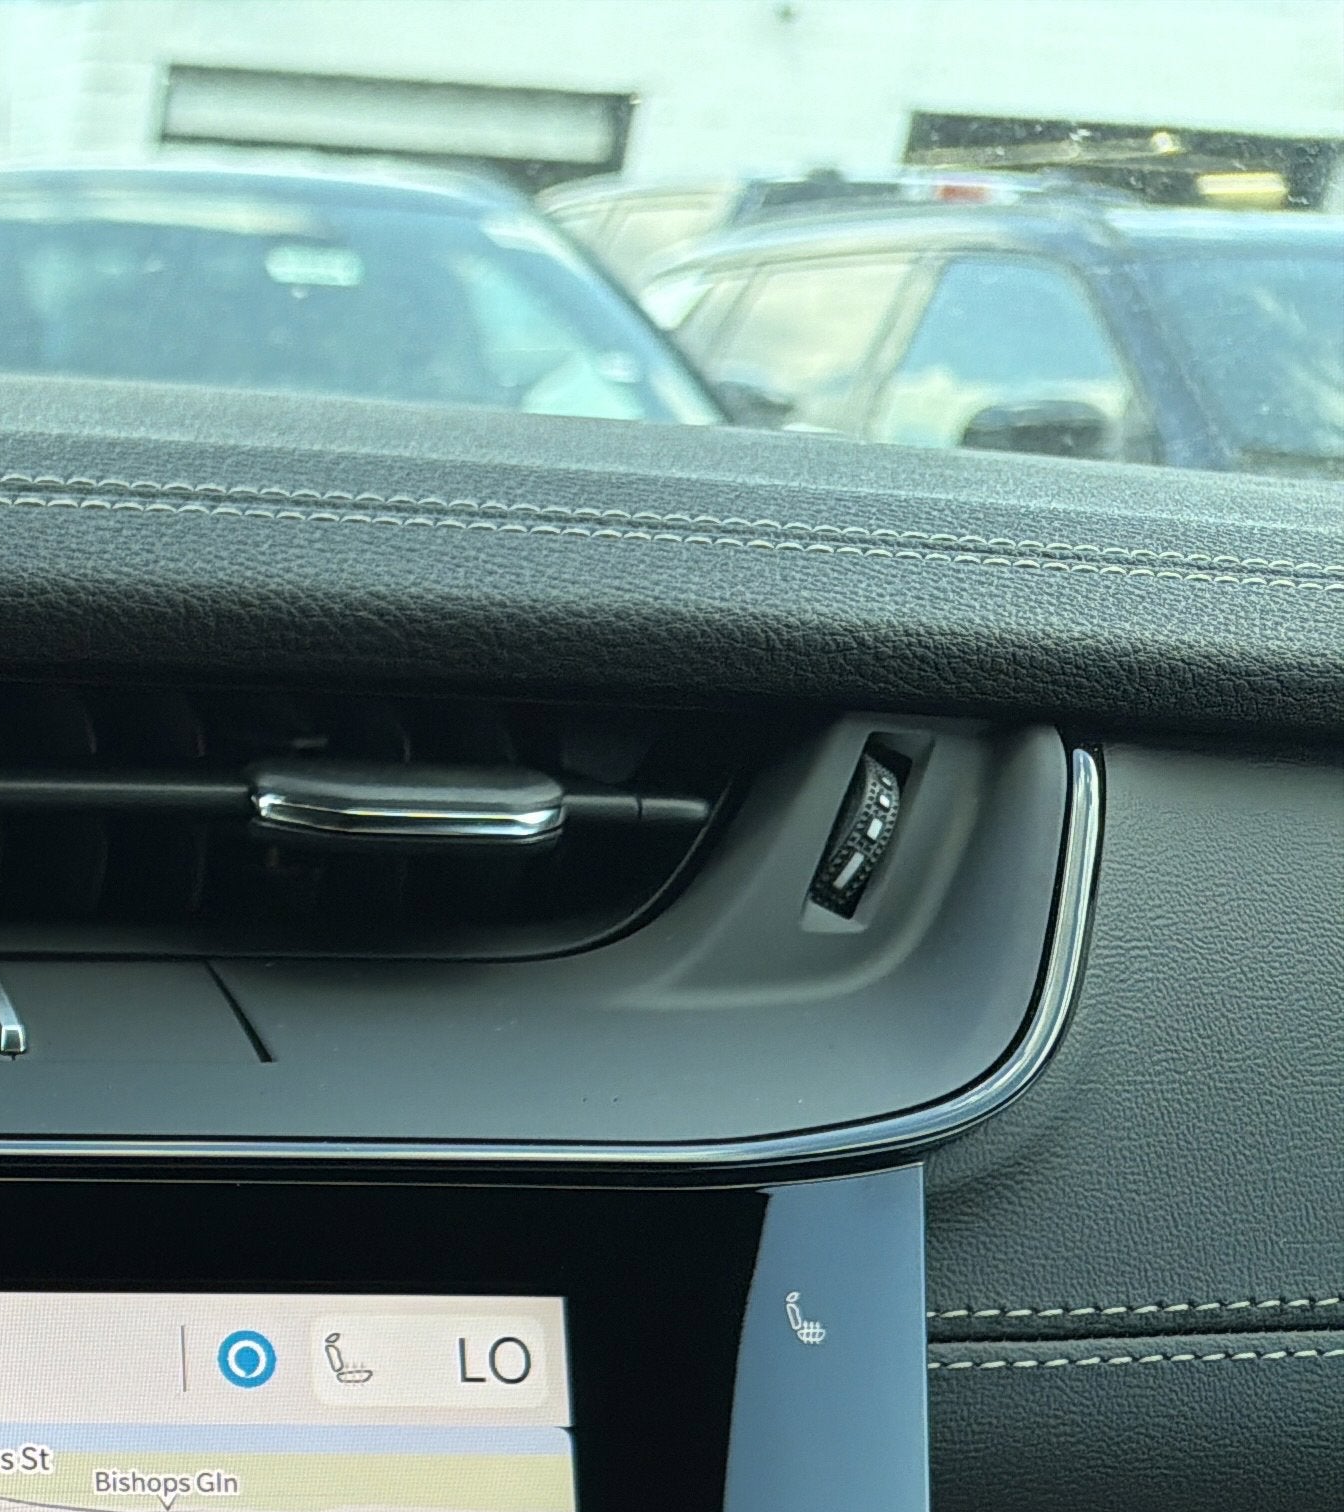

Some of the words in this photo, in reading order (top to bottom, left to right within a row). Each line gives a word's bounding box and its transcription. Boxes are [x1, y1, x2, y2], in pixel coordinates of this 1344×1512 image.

[459, 1337, 532, 1384] LO
[20, 1446, 51, 1471] St
[95, 1471, 191, 1500] Bishops
